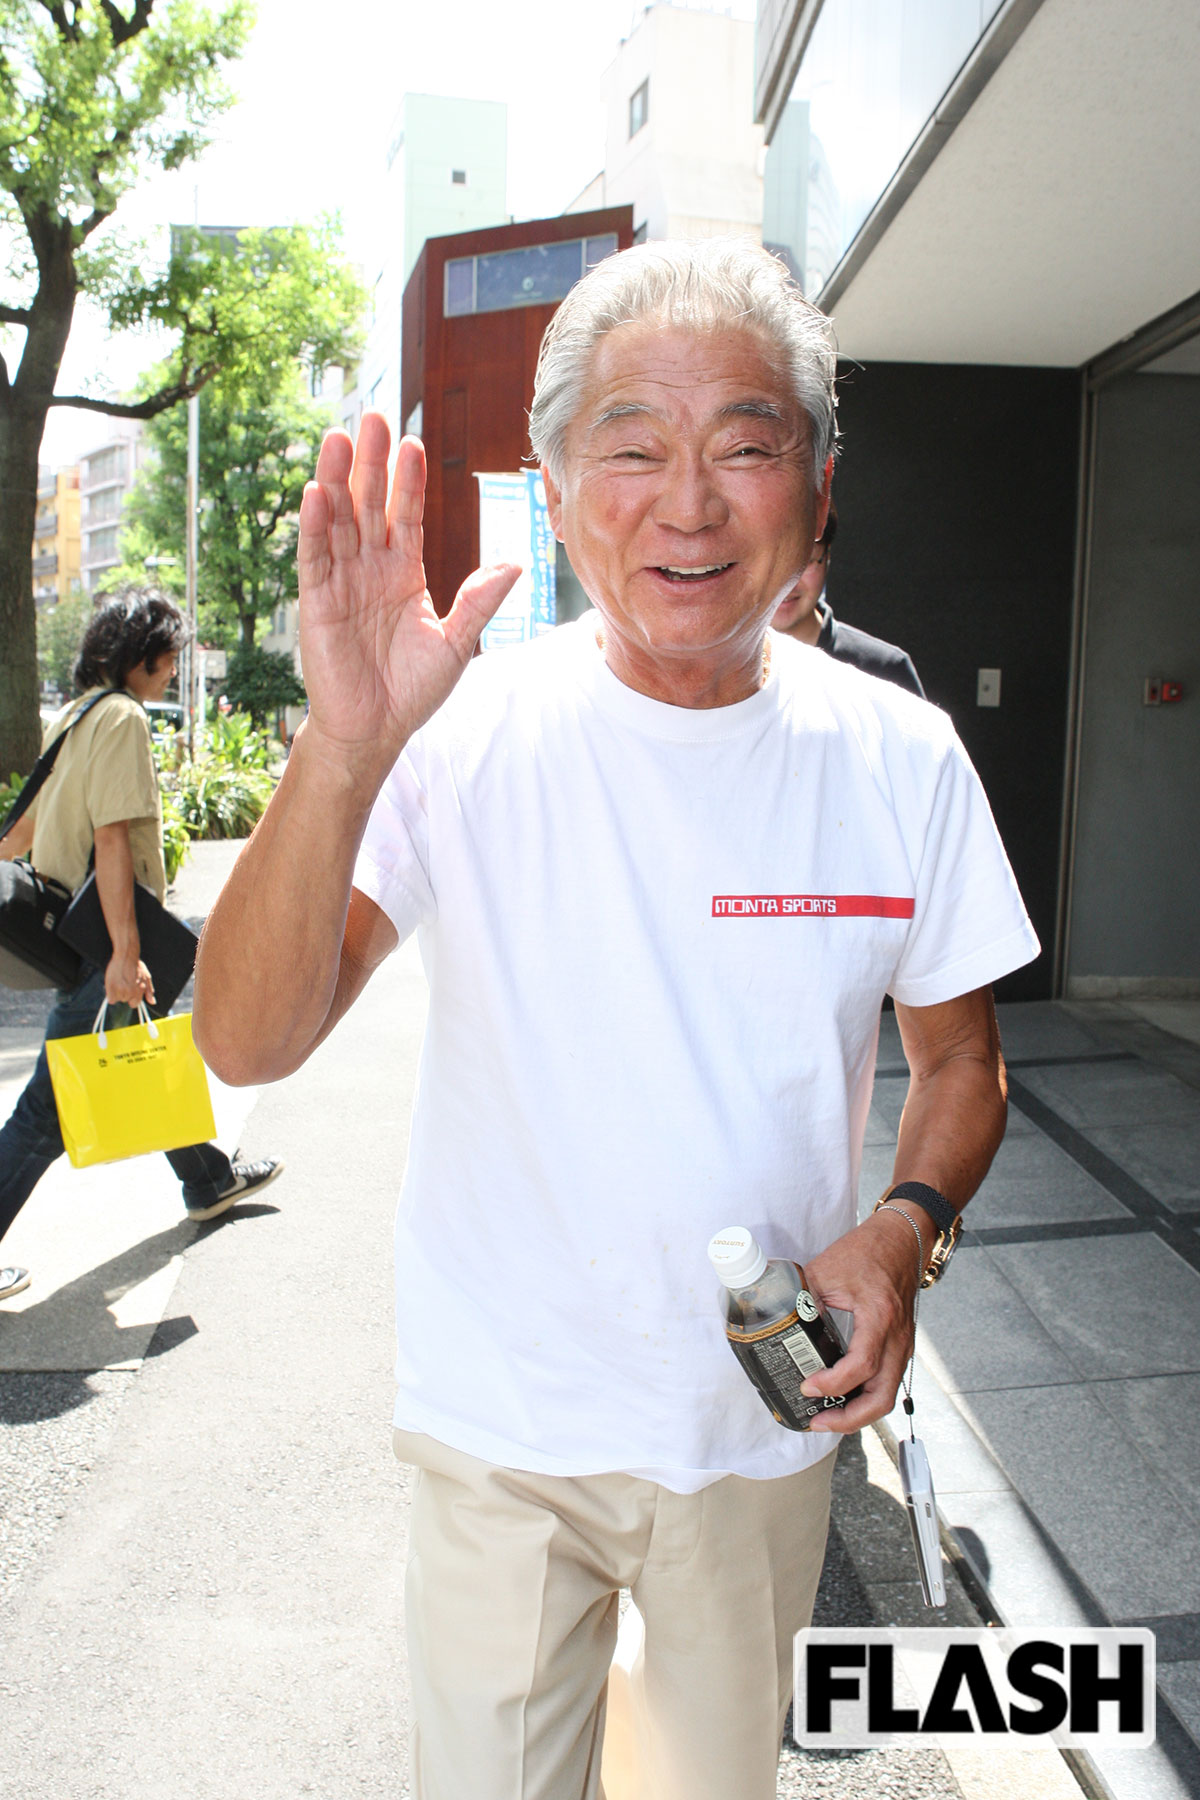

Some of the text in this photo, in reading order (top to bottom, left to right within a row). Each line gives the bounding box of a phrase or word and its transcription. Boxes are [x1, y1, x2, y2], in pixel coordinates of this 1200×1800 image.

[715, 899, 837, 913] MONTA SPORTS
[712, 1239, 745, 1247] SUNTORY
